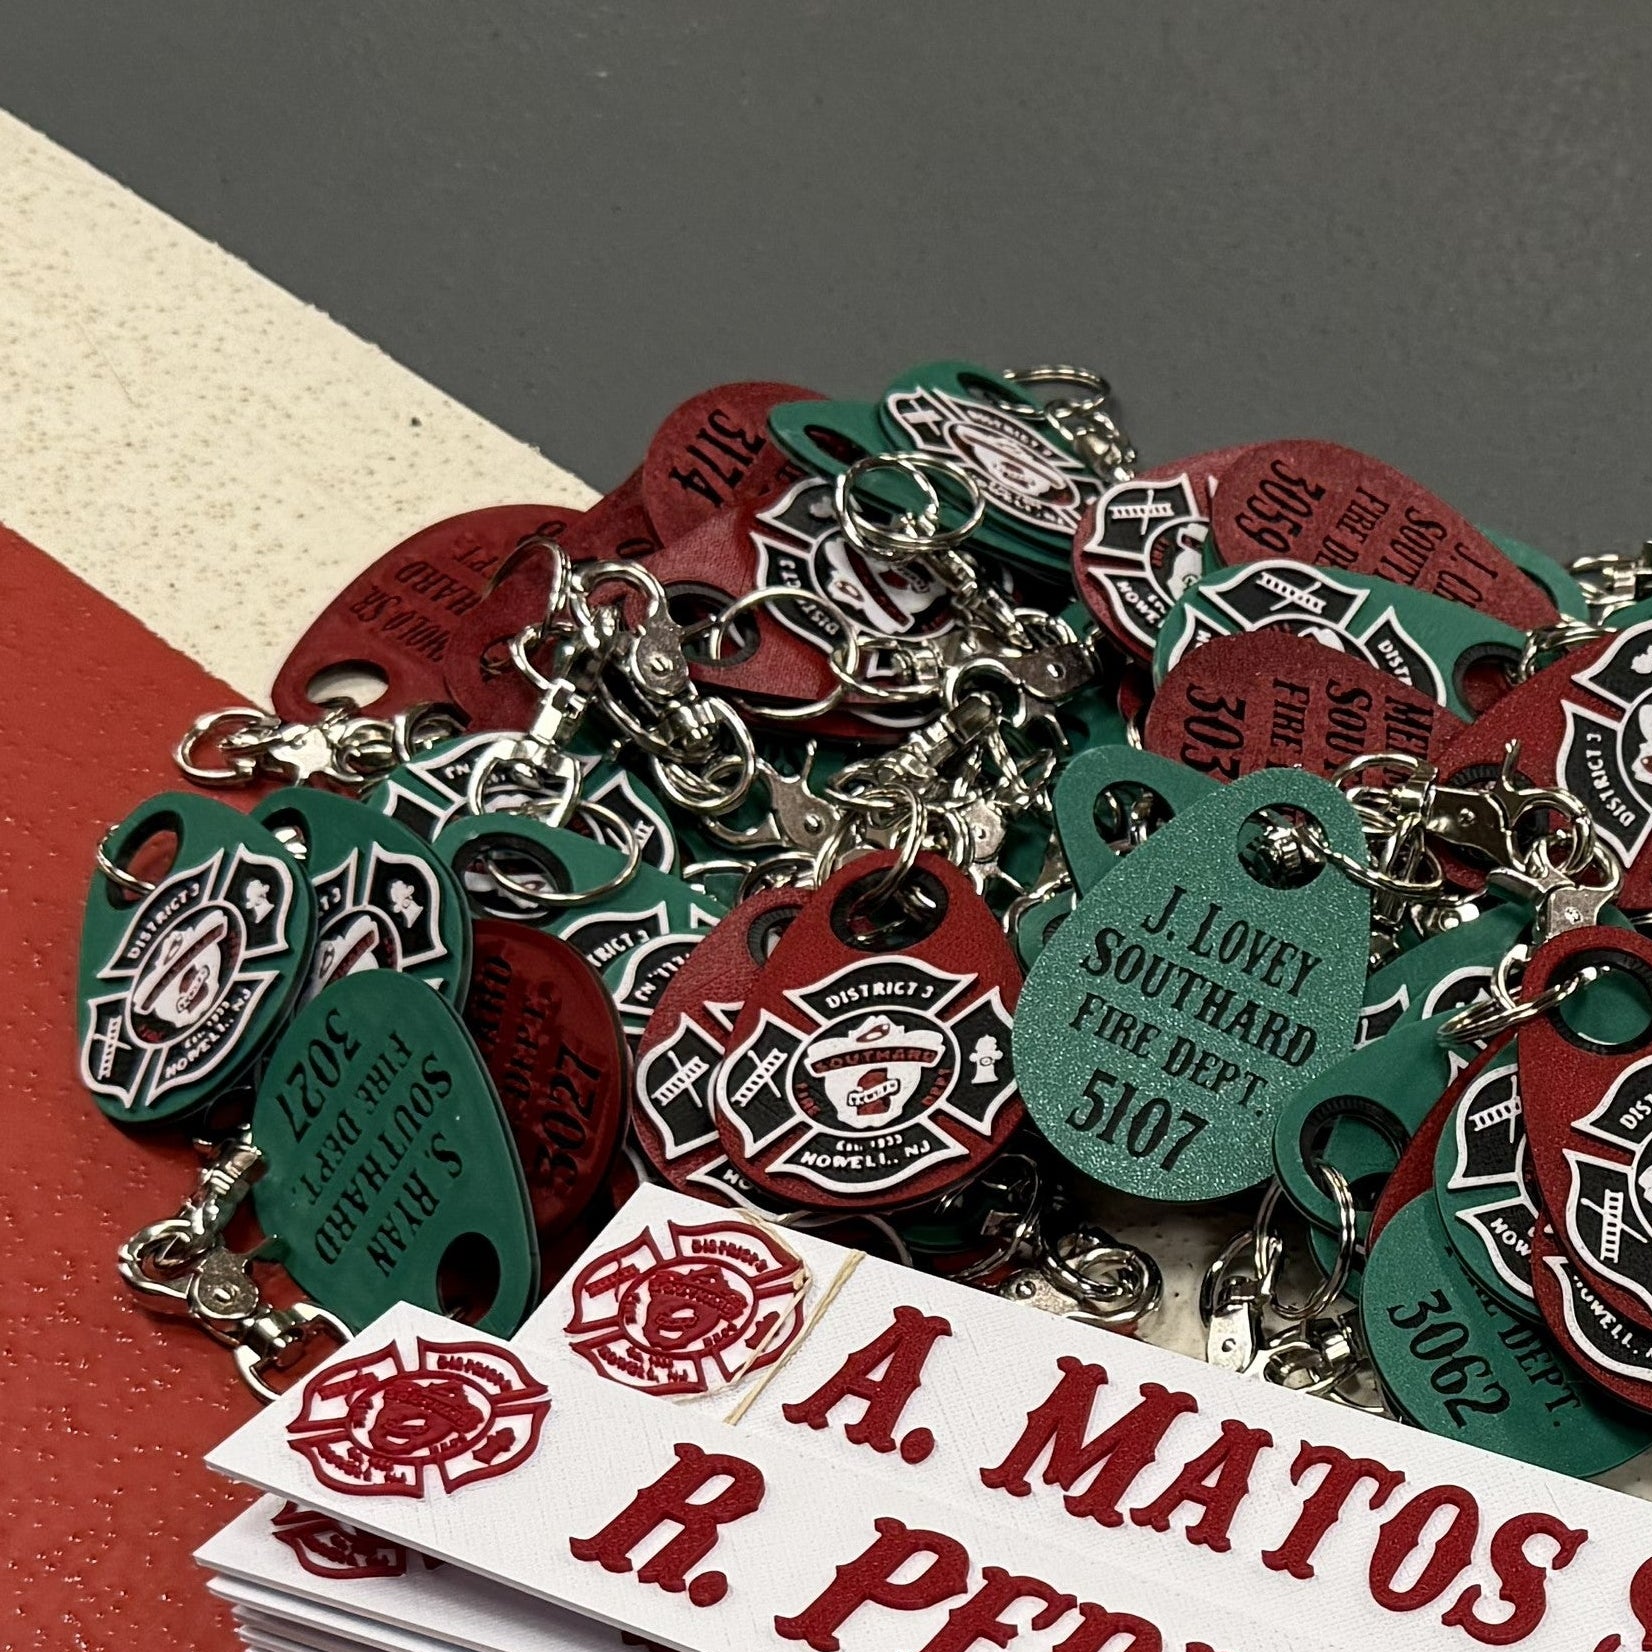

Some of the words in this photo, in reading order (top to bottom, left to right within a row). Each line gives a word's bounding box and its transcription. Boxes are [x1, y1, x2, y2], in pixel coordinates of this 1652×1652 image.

[668, 408, 767, 509] 3174
[1234, 460, 1326, 553] 3059
[1336, 486, 1390, 544] FIRE
[1450, 542, 1499, 580] J.
[1180, 682, 1246, 781] 303
[1269, 677, 1311, 751] FIRE
[1586, 733, 1602, 743] 3
[1586, 749, 1636, 828] DISTRICT
[127, 890, 193, 960] DISTRICT
[189, 883, 199, 897] 3
[1140, 884, 1187, 942] J.
[1186, 902, 1323, 997] LOVEY
[825, 981, 919, 1009] DISTRICT
[922, 985, 935, 999] 3
[1079, 927, 1318, 1068] SOUTHARD
[275, 1007, 362, 1144] 3027
[355, 1030, 415, 1115] FIRE
[814, 1048, 936, 1072] SOUTHARD
[1068, 992, 1162, 1058] FIRE
[1161, 1035, 1269, 1117] DEPT.
[315, 1053, 453, 1265] SOUTHARD
[424, 1131, 463, 1179] S.
[904, 1139, 931, 1157] NJ
[1065, 1067, 1209, 1172] 5107
[366, 1167, 441, 1278] RYAN
[1386, 1288, 1511, 1429] 3062
[1496, 1322, 1582, 1427] DEPT.
[569, 1442, 767, 1608] R.
[781, 1304, 954, 1467] A.
[979, 1351, 1591, 1651] MATOS
